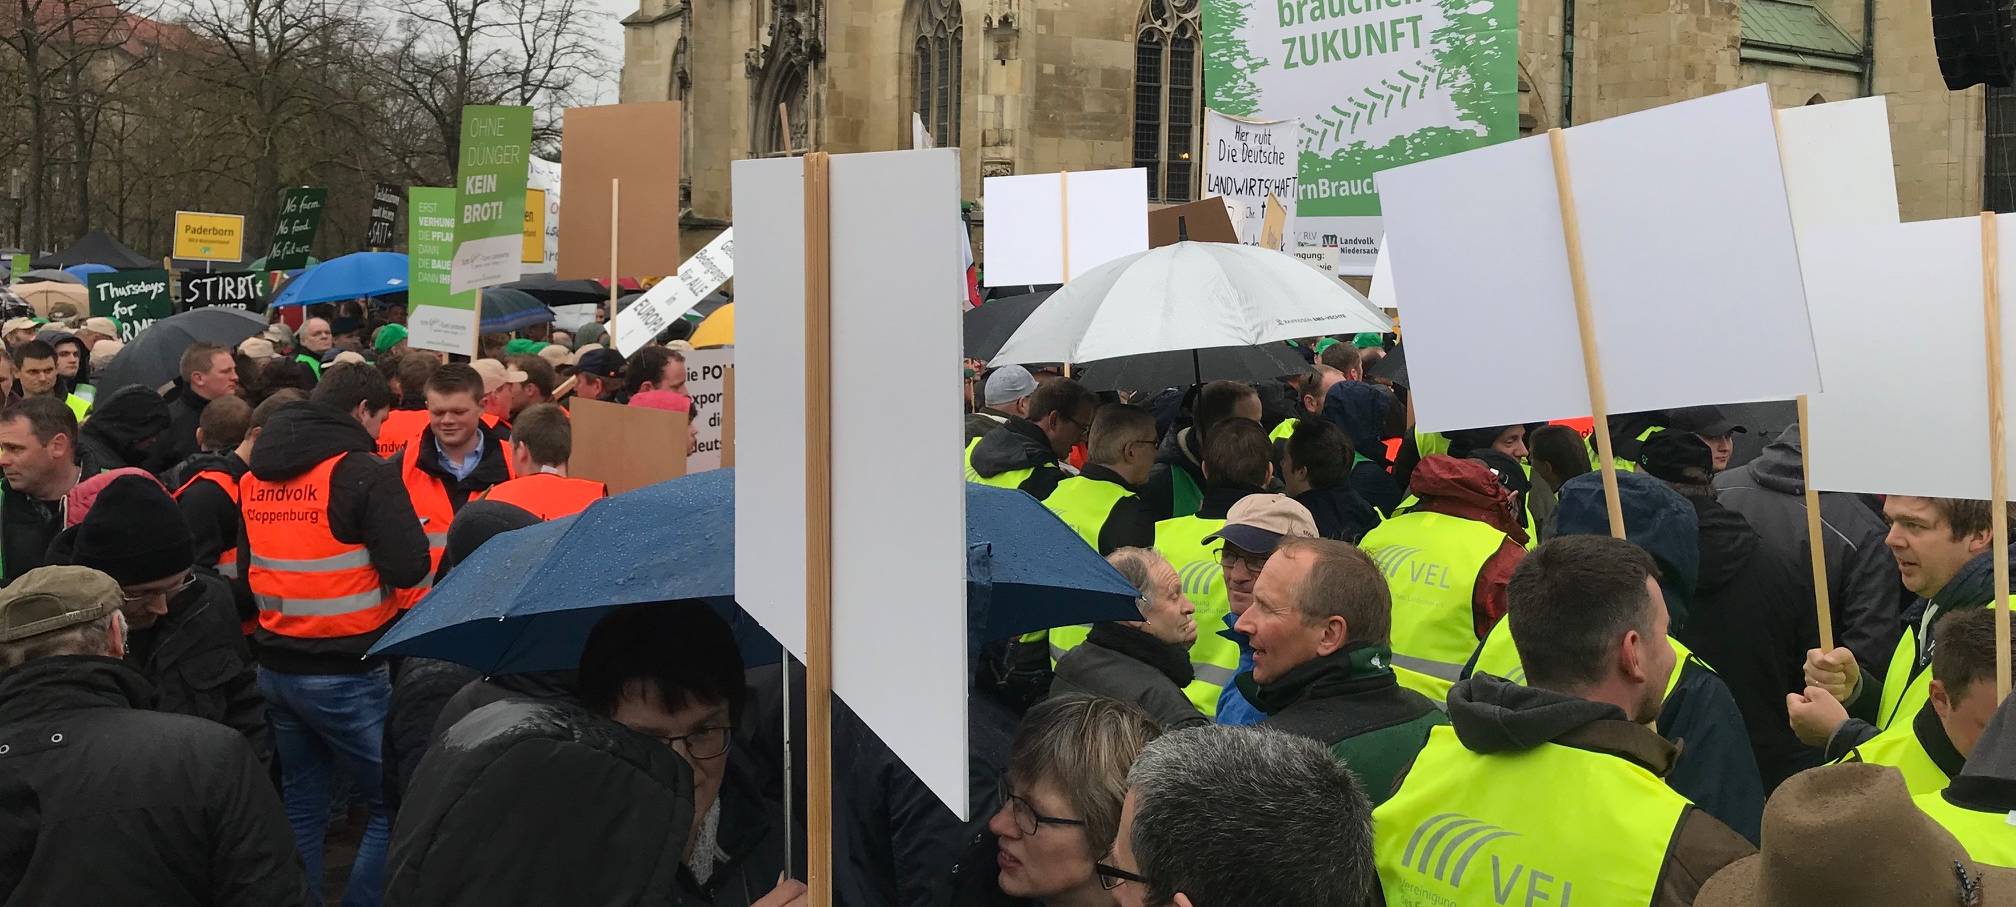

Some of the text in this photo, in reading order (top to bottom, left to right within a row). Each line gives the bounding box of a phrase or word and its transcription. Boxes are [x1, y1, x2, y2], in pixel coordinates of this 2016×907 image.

[1282, 15, 1423, 69] ZUKUNFT
[470, 117, 505, 138] OHNE
[1235, 125, 1272, 146] Hier ruht
[467, 142, 521, 167] DÜNGER
[1218, 139, 1285, 165] Die Deutsche
[465, 174, 497, 195] KEIN
[1207, 174, 1298, 198] LANDWIRTSCHAFT
[282, 196, 297, 215] No
[418, 202, 437, 213] ERST
[463, 201, 503, 224] BROT!
[184, 224, 235, 237] Paderborn
[276, 218, 289, 236] No
[418, 230, 431, 241] DIE
[418, 244, 439, 255] DANN
[1340, 236, 1375, 245] Landvolk
[268, 241, 281, 260] No
[1340, 246, 1379, 255] Niedersach
[418, 258, 431, 269] DIE
[418, 271, 439, 283] DANN
[96, 280, 166, 301] Thursdays
[185, 273, 256, 303] STIRBT
[688, 277, 709, 297] ALLE
[112, 301, 137, 320] for
[633, 298, 667, 335] EUROPA
[250, 484, 318, 502] Landvolk
[1410, 560, 1450, 589] VEL
